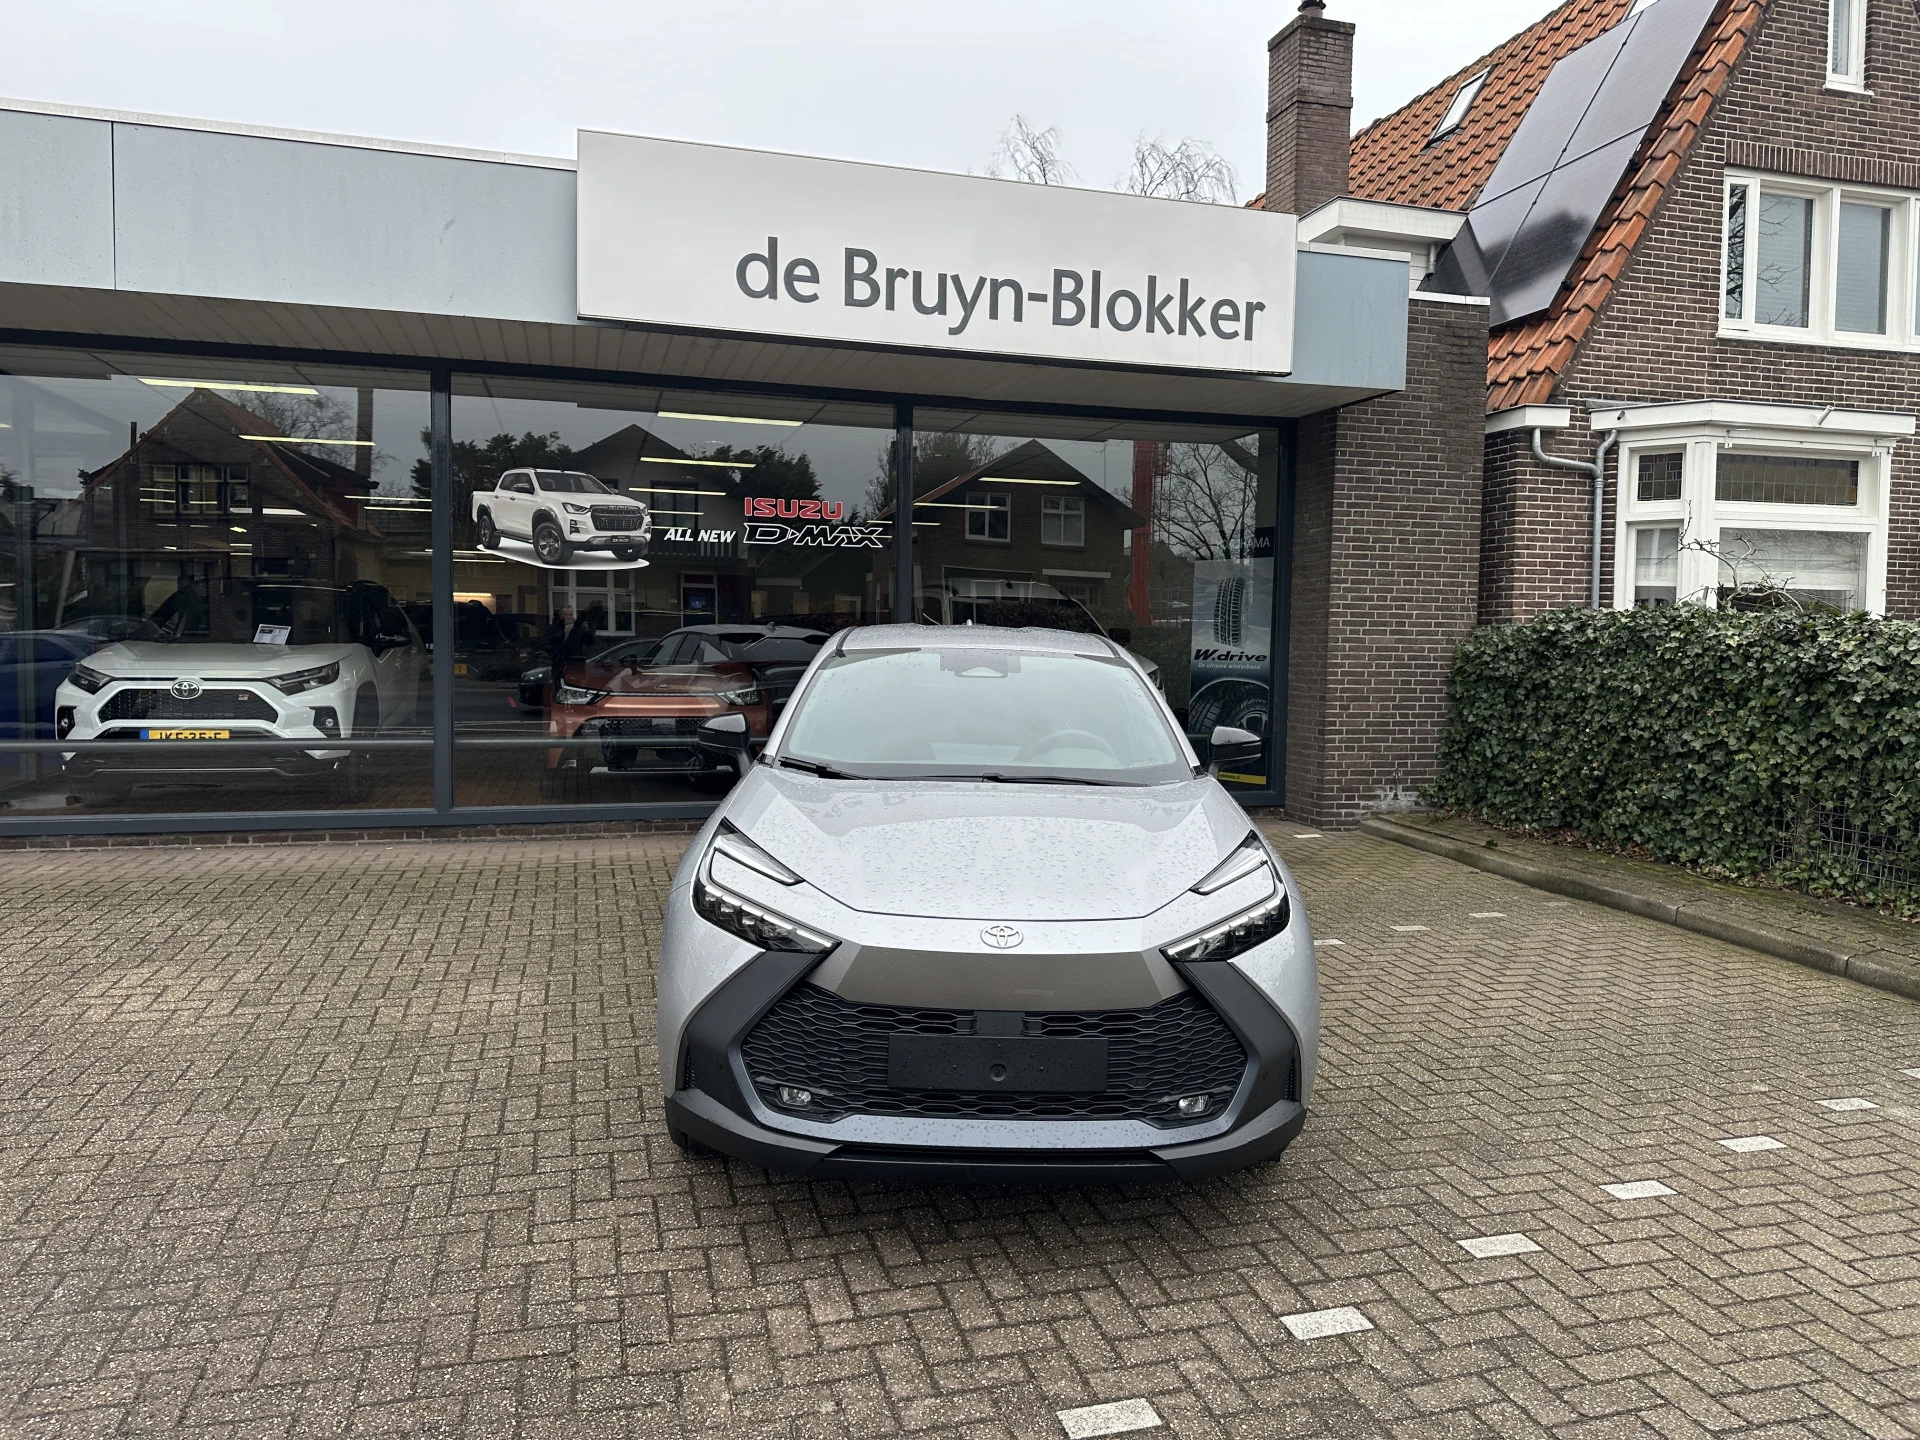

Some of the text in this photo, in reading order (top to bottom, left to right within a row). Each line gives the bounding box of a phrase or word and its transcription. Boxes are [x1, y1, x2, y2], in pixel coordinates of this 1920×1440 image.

[735, 236, 1266, 342] de Bruyn-Blokker
[744, 497, 843, 520] ISUZU
[663, 528, 694, 542] ALL
[697, 530, 736, 543] NEW
[1193, 648, 1268, 662] W.drive
